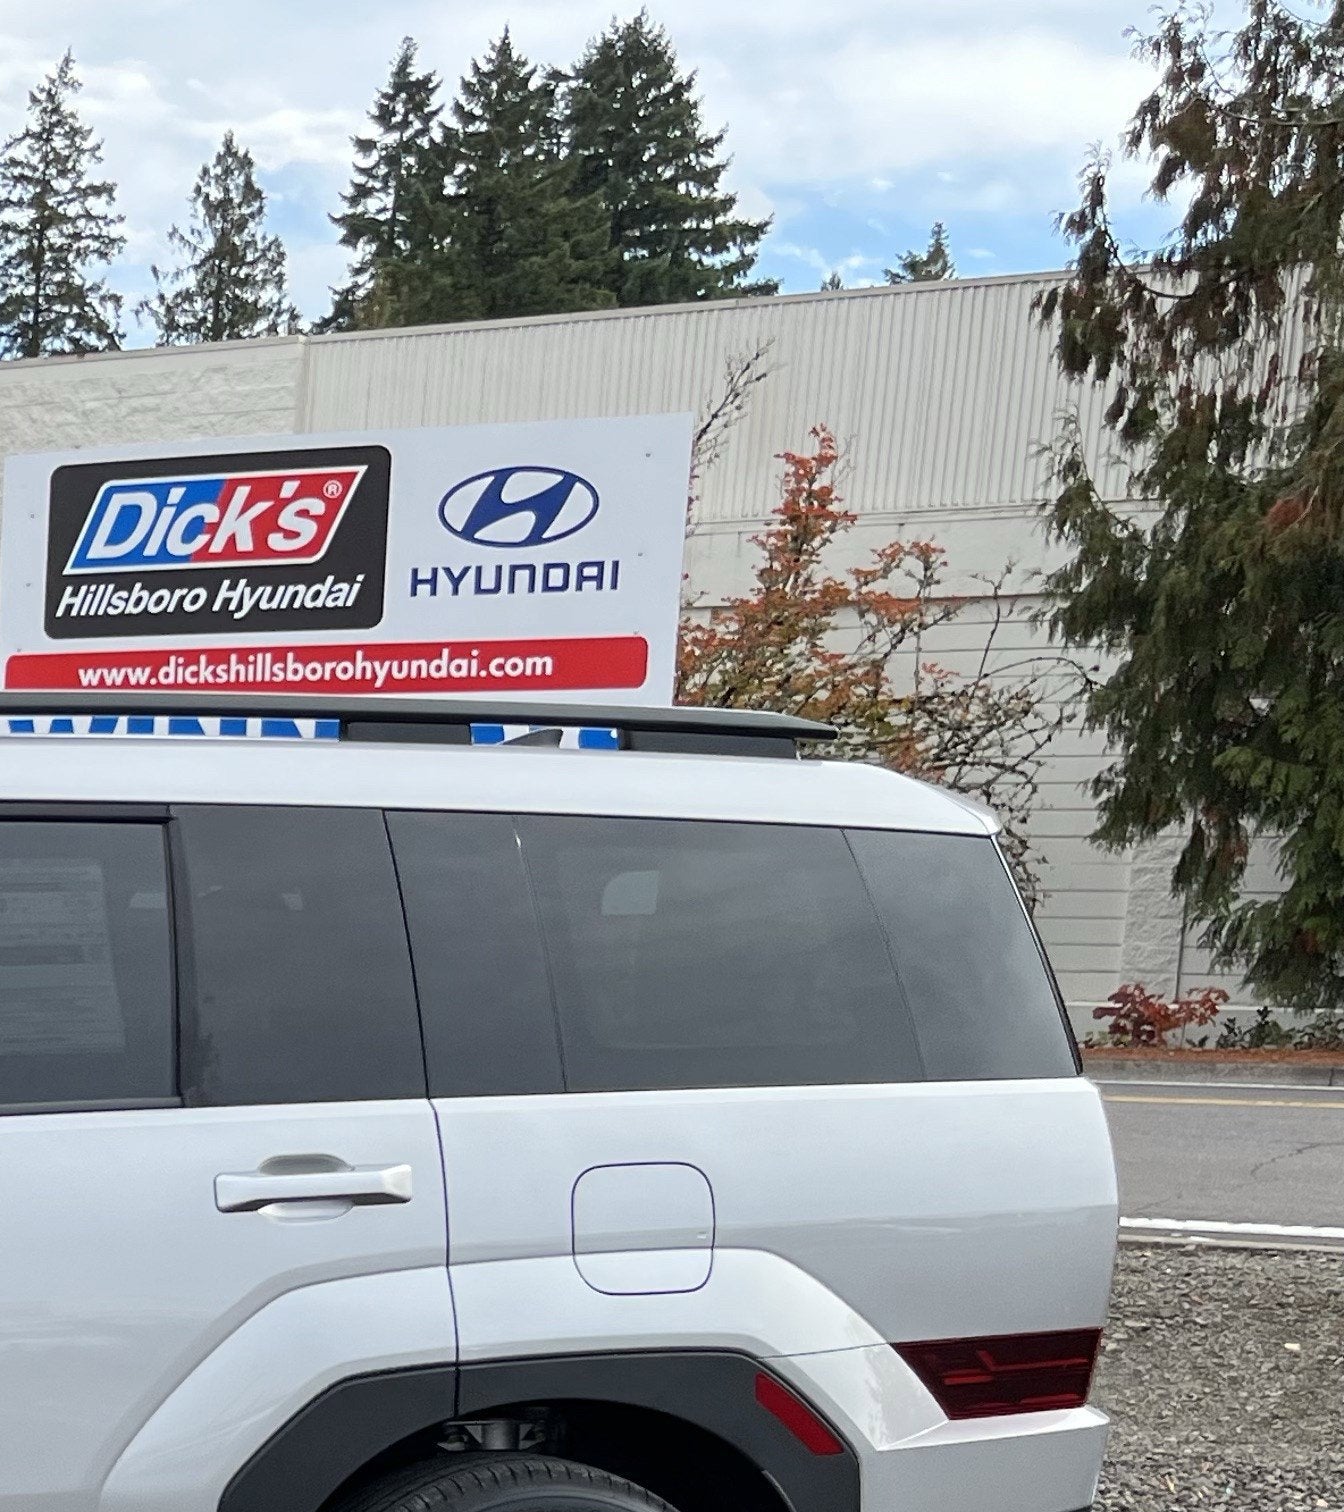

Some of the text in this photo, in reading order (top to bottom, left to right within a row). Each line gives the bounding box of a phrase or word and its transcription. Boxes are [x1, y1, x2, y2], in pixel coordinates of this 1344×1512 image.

[55, 573, 366, 620] Hillsboro Hyundai
[411, 559, 620, 598] HYUNDAI
[77, 649, 554, 689] www.dickshillsborohyundai.com
